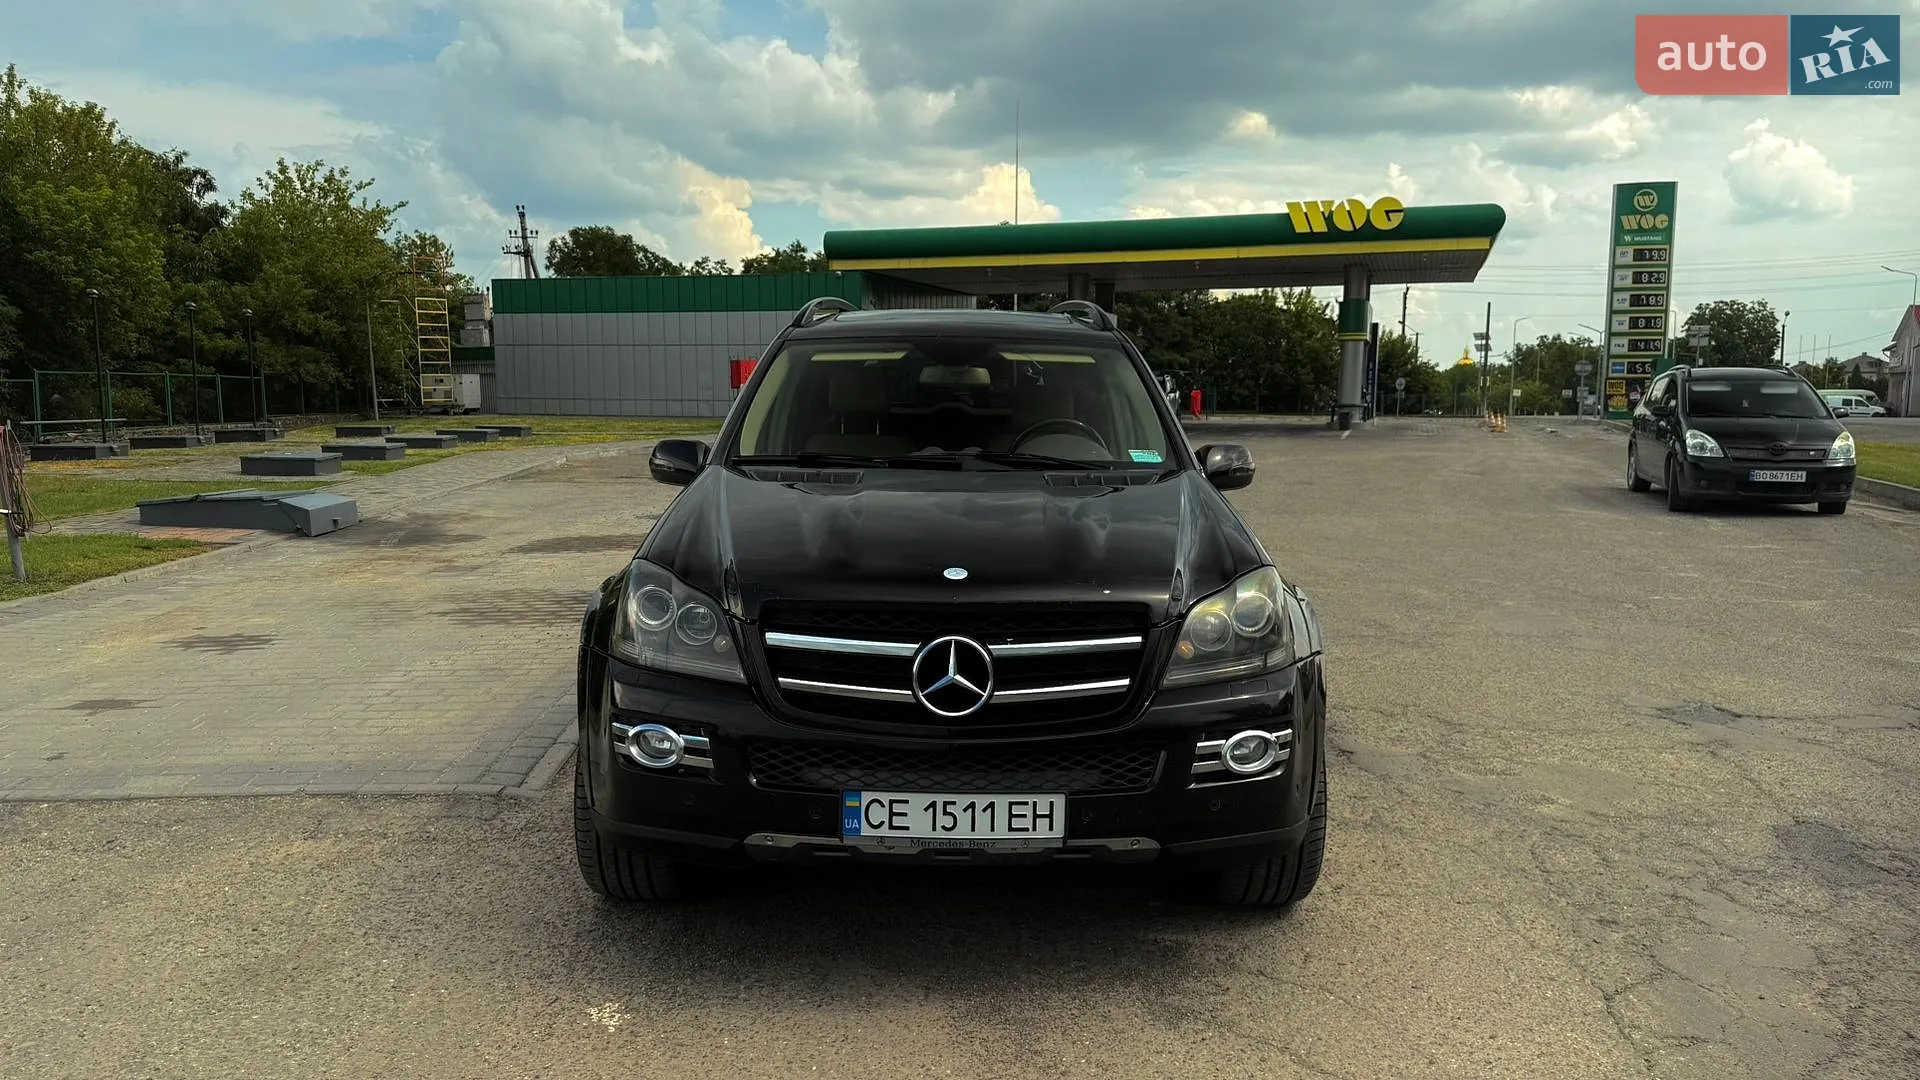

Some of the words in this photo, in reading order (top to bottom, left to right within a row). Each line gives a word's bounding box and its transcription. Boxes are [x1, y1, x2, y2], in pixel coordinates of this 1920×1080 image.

[1285, 196, 1404, 233] WOG
[1620, 213, 1669, 230] WOG
[1635, 363, 1651, 373] 56
[1768, 472, 1790, 480] 8671
[1790, 472, 1804, 481] EH
[864, 798, 911, 831] CE
[923, 800, 996, 832] 1511
[1007, 800, 1055, 832] EH
[845, 819, 859, 829] UA
[910, 839, 997, 849] Mercedes-Benz
